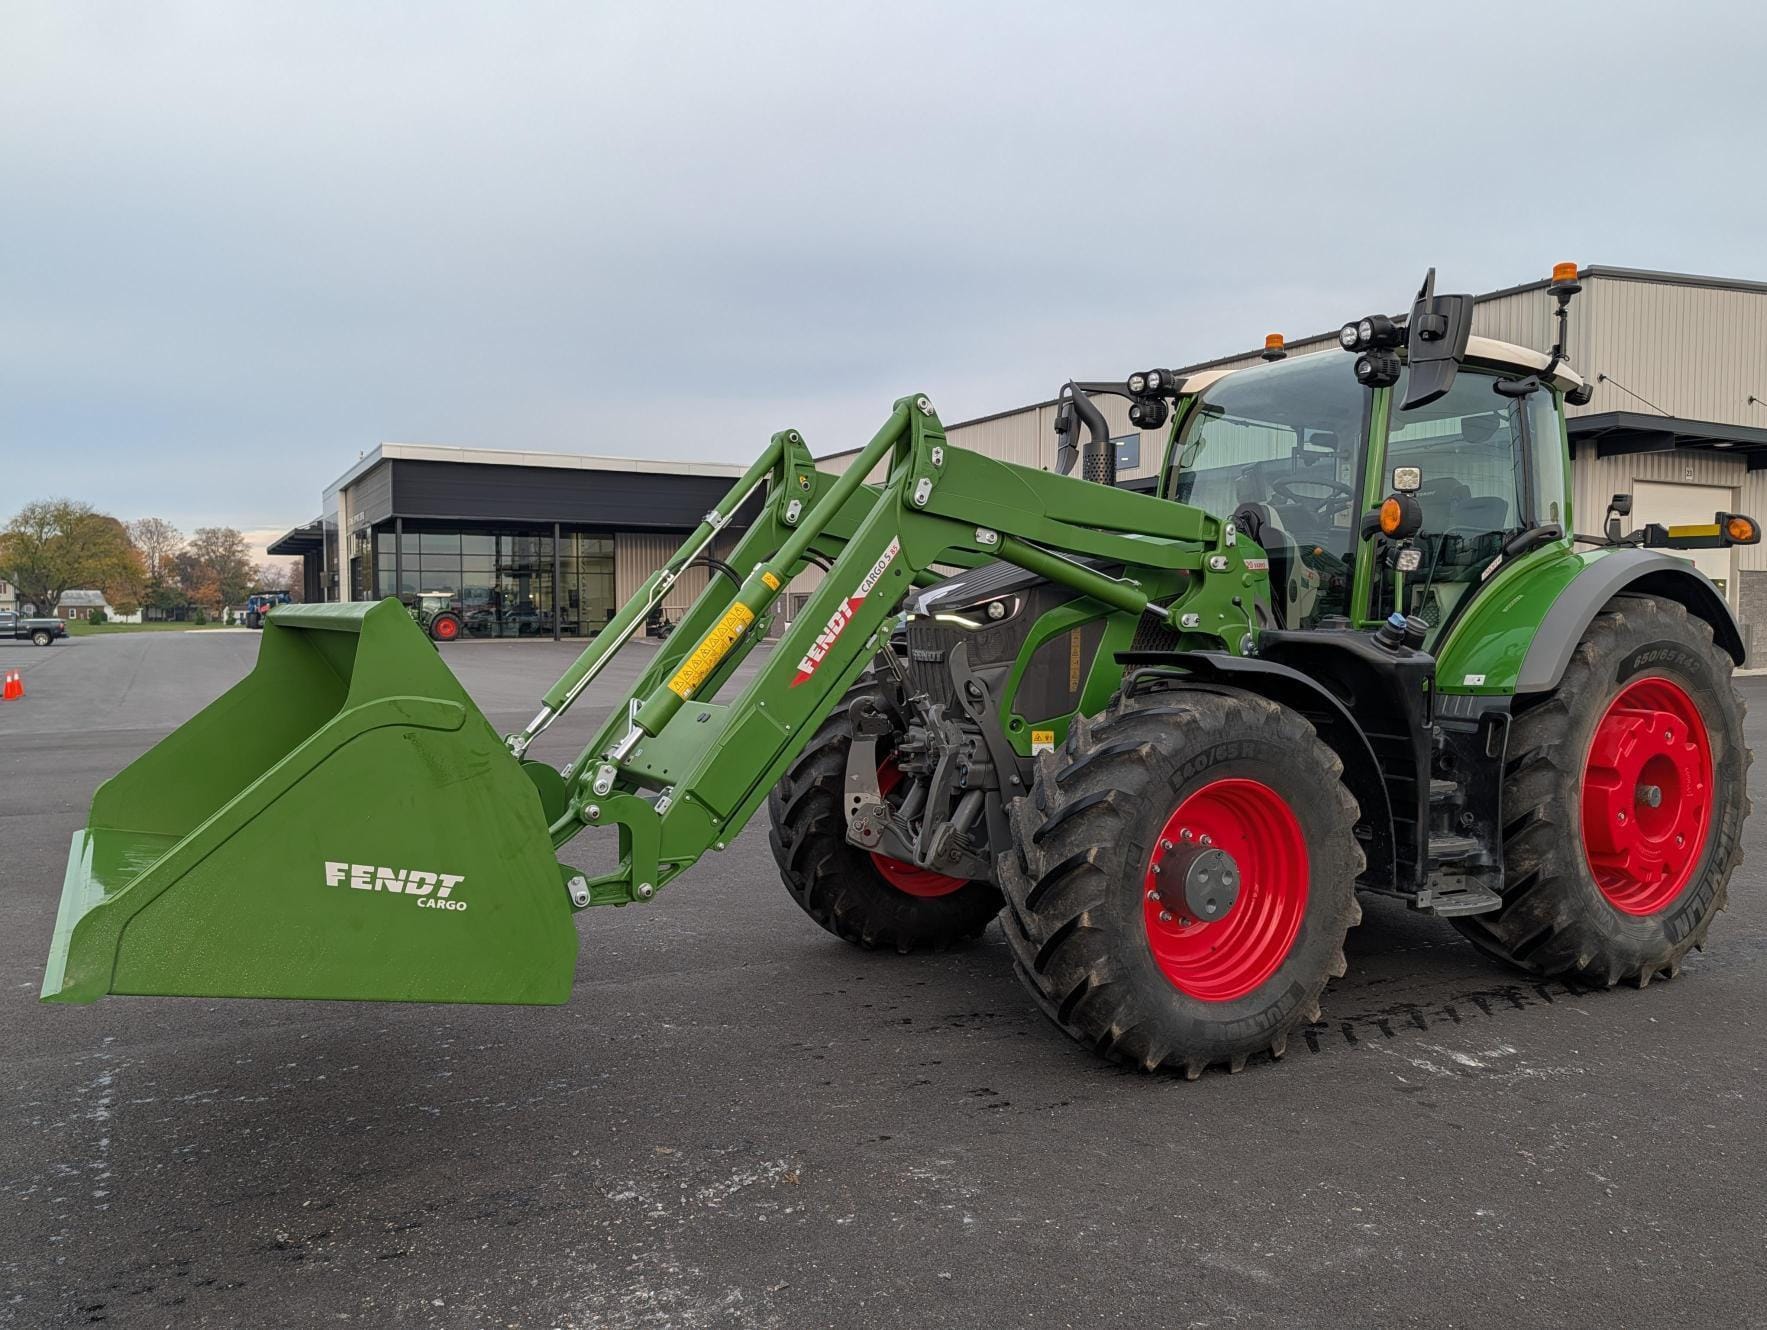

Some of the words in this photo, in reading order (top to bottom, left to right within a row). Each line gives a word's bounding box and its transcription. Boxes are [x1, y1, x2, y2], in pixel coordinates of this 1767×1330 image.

[797, 596, 853, 674] FENDT
[861, 560, 886, 593] CARGO
[325, 861, 465, 898] FENDT
[417, 898, 467, 911] CARGO
